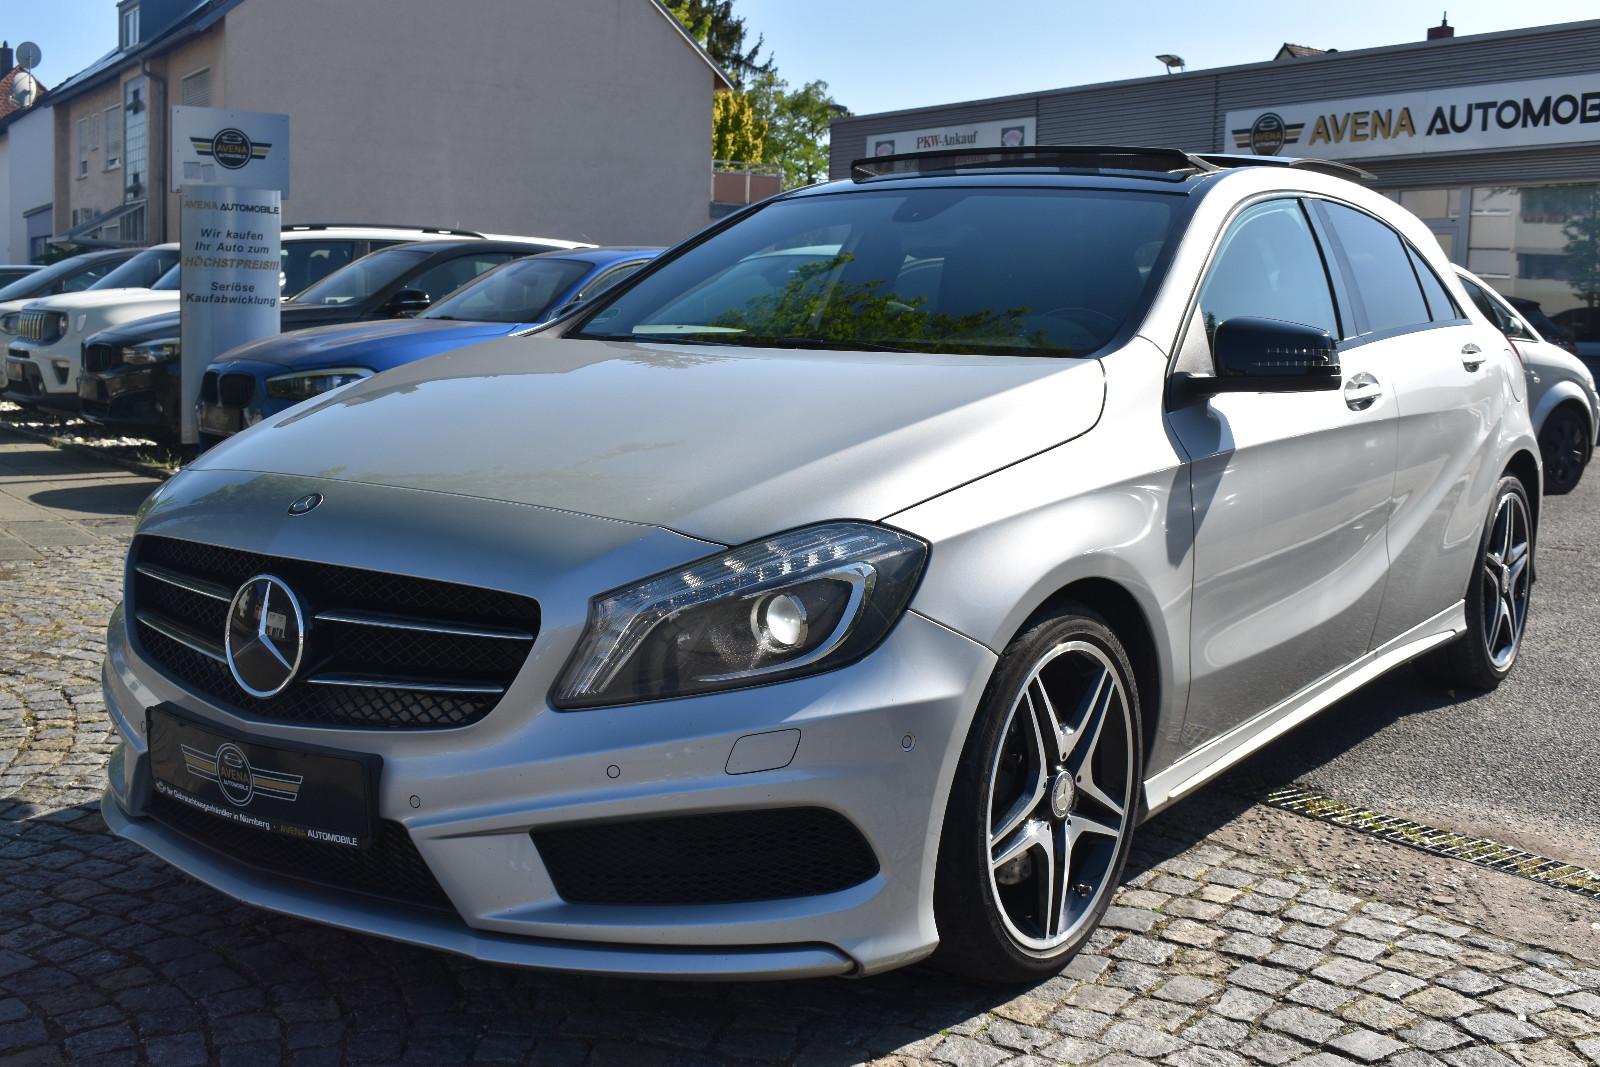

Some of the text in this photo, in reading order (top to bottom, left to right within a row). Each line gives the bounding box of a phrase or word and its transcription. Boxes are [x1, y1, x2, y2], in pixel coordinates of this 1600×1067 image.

[1307, 107, 1416, 146] AVENA
[916, 130, 979, 149] PKW-Ankauf
[216, 144, 248, 154] AVENA
[184, 200, 280, 215] AVENA AUTOMOBILE
[200, 228, 264, 240] Wir kaufen
[194, 241, 270, 254] Ihr Auto zum
[184, 256, 280, 271] HÖCHSTPREIS!!!
[210, 281, 256, 293] Seriöse
[186, 293, 276, 307] Kaufabwicklung
[220, 766, 250, 785] AVENA
[239, 813, 271, 831] Nürnberg
[307, 829, 358, 847] AUTOMOBILE
